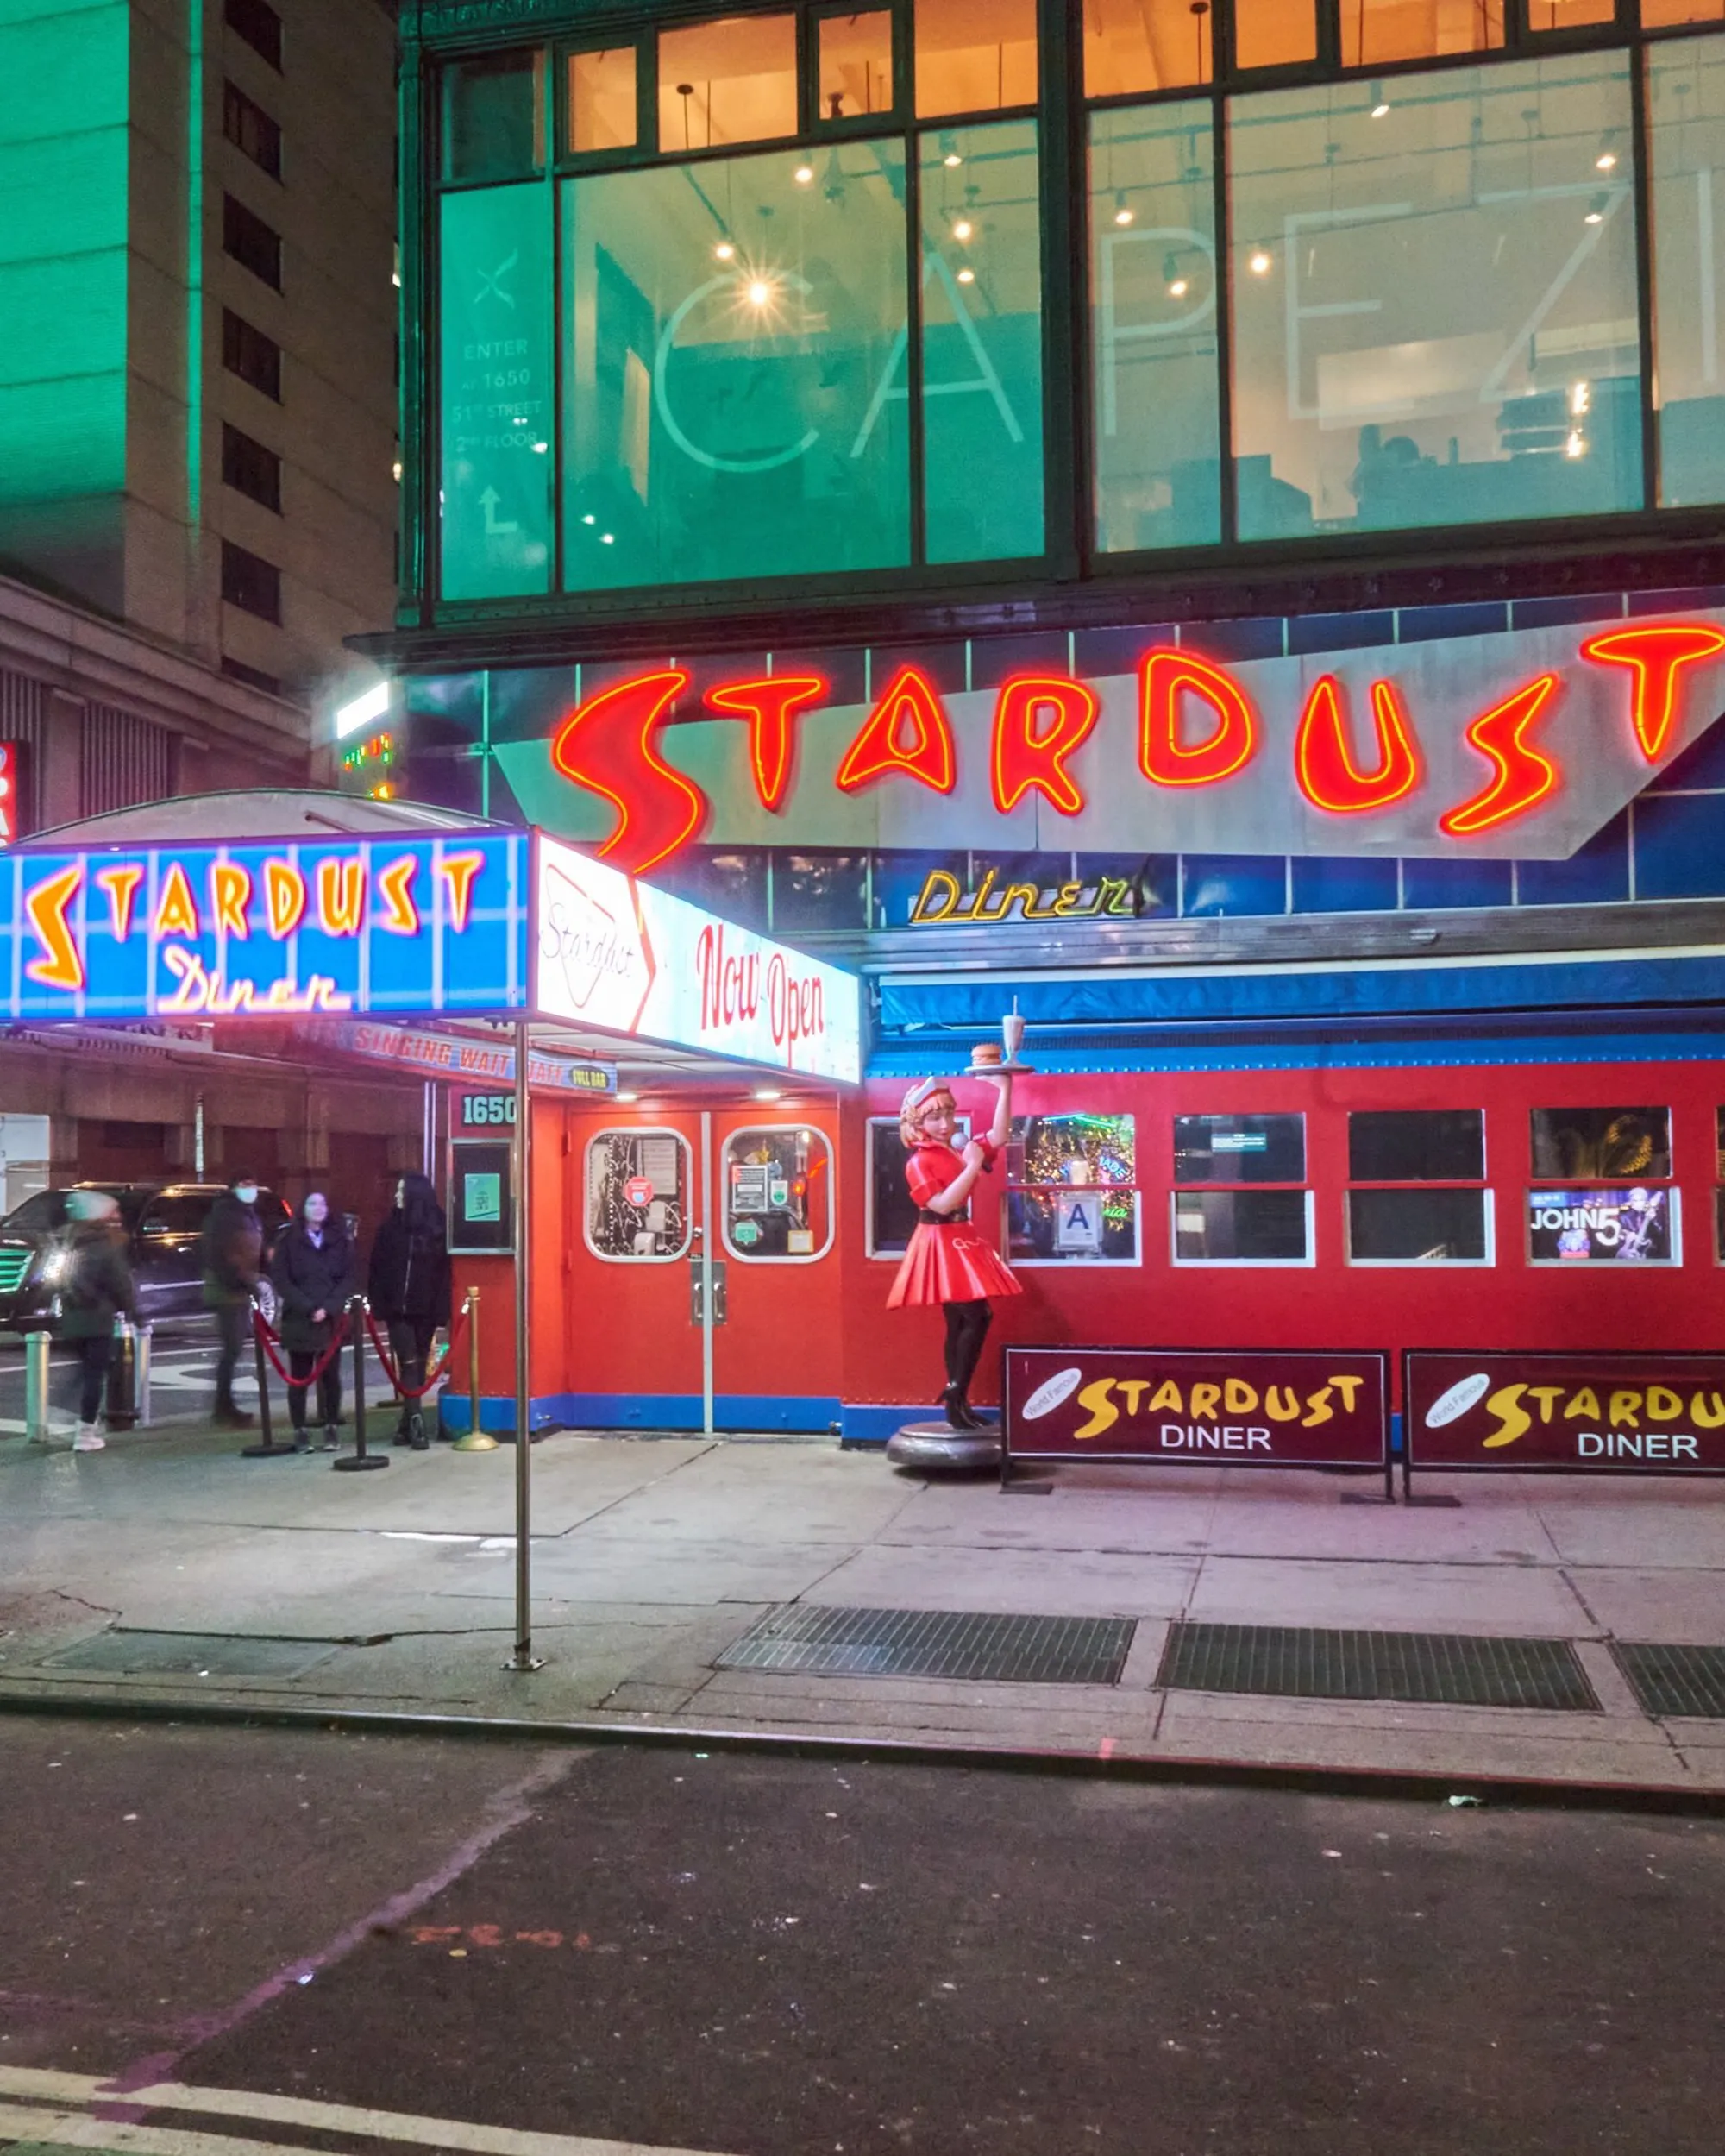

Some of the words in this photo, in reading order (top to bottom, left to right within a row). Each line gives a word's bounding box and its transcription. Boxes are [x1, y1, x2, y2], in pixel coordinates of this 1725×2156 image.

[464, 338, 529, 361] ENTER
[483, 368, 530, 388] 1650
[486, 399, 543, 419] STREET
[484, 431, 540, 449] FLOOR
[554, 624, 1725, 873] STARDUST
[910, 867, 1135, 924] Diner
[24, 850, 485, 990] STARDUST
[156, 943, 352, 1014] Diner
[696, 923, 762, 1032] Now
[767, 952, 825, 1070] Open
[352, 1024, 453, 1067] SINGING
[458, 1044, 511, 1078] WAIT
[528, 1059, 563, 1086] TAFF
[463, 1096, 518, 1124] 1650
[1066, 1204, 1089, 1229] A
[1074, 1375, 1364, 1439] STARDUST
[1483, 1384, 1725, 1449] STARDU
[1161, 1424, 1273, 1450] DINER
[1578, 1433, 1699, 1459] DINER
